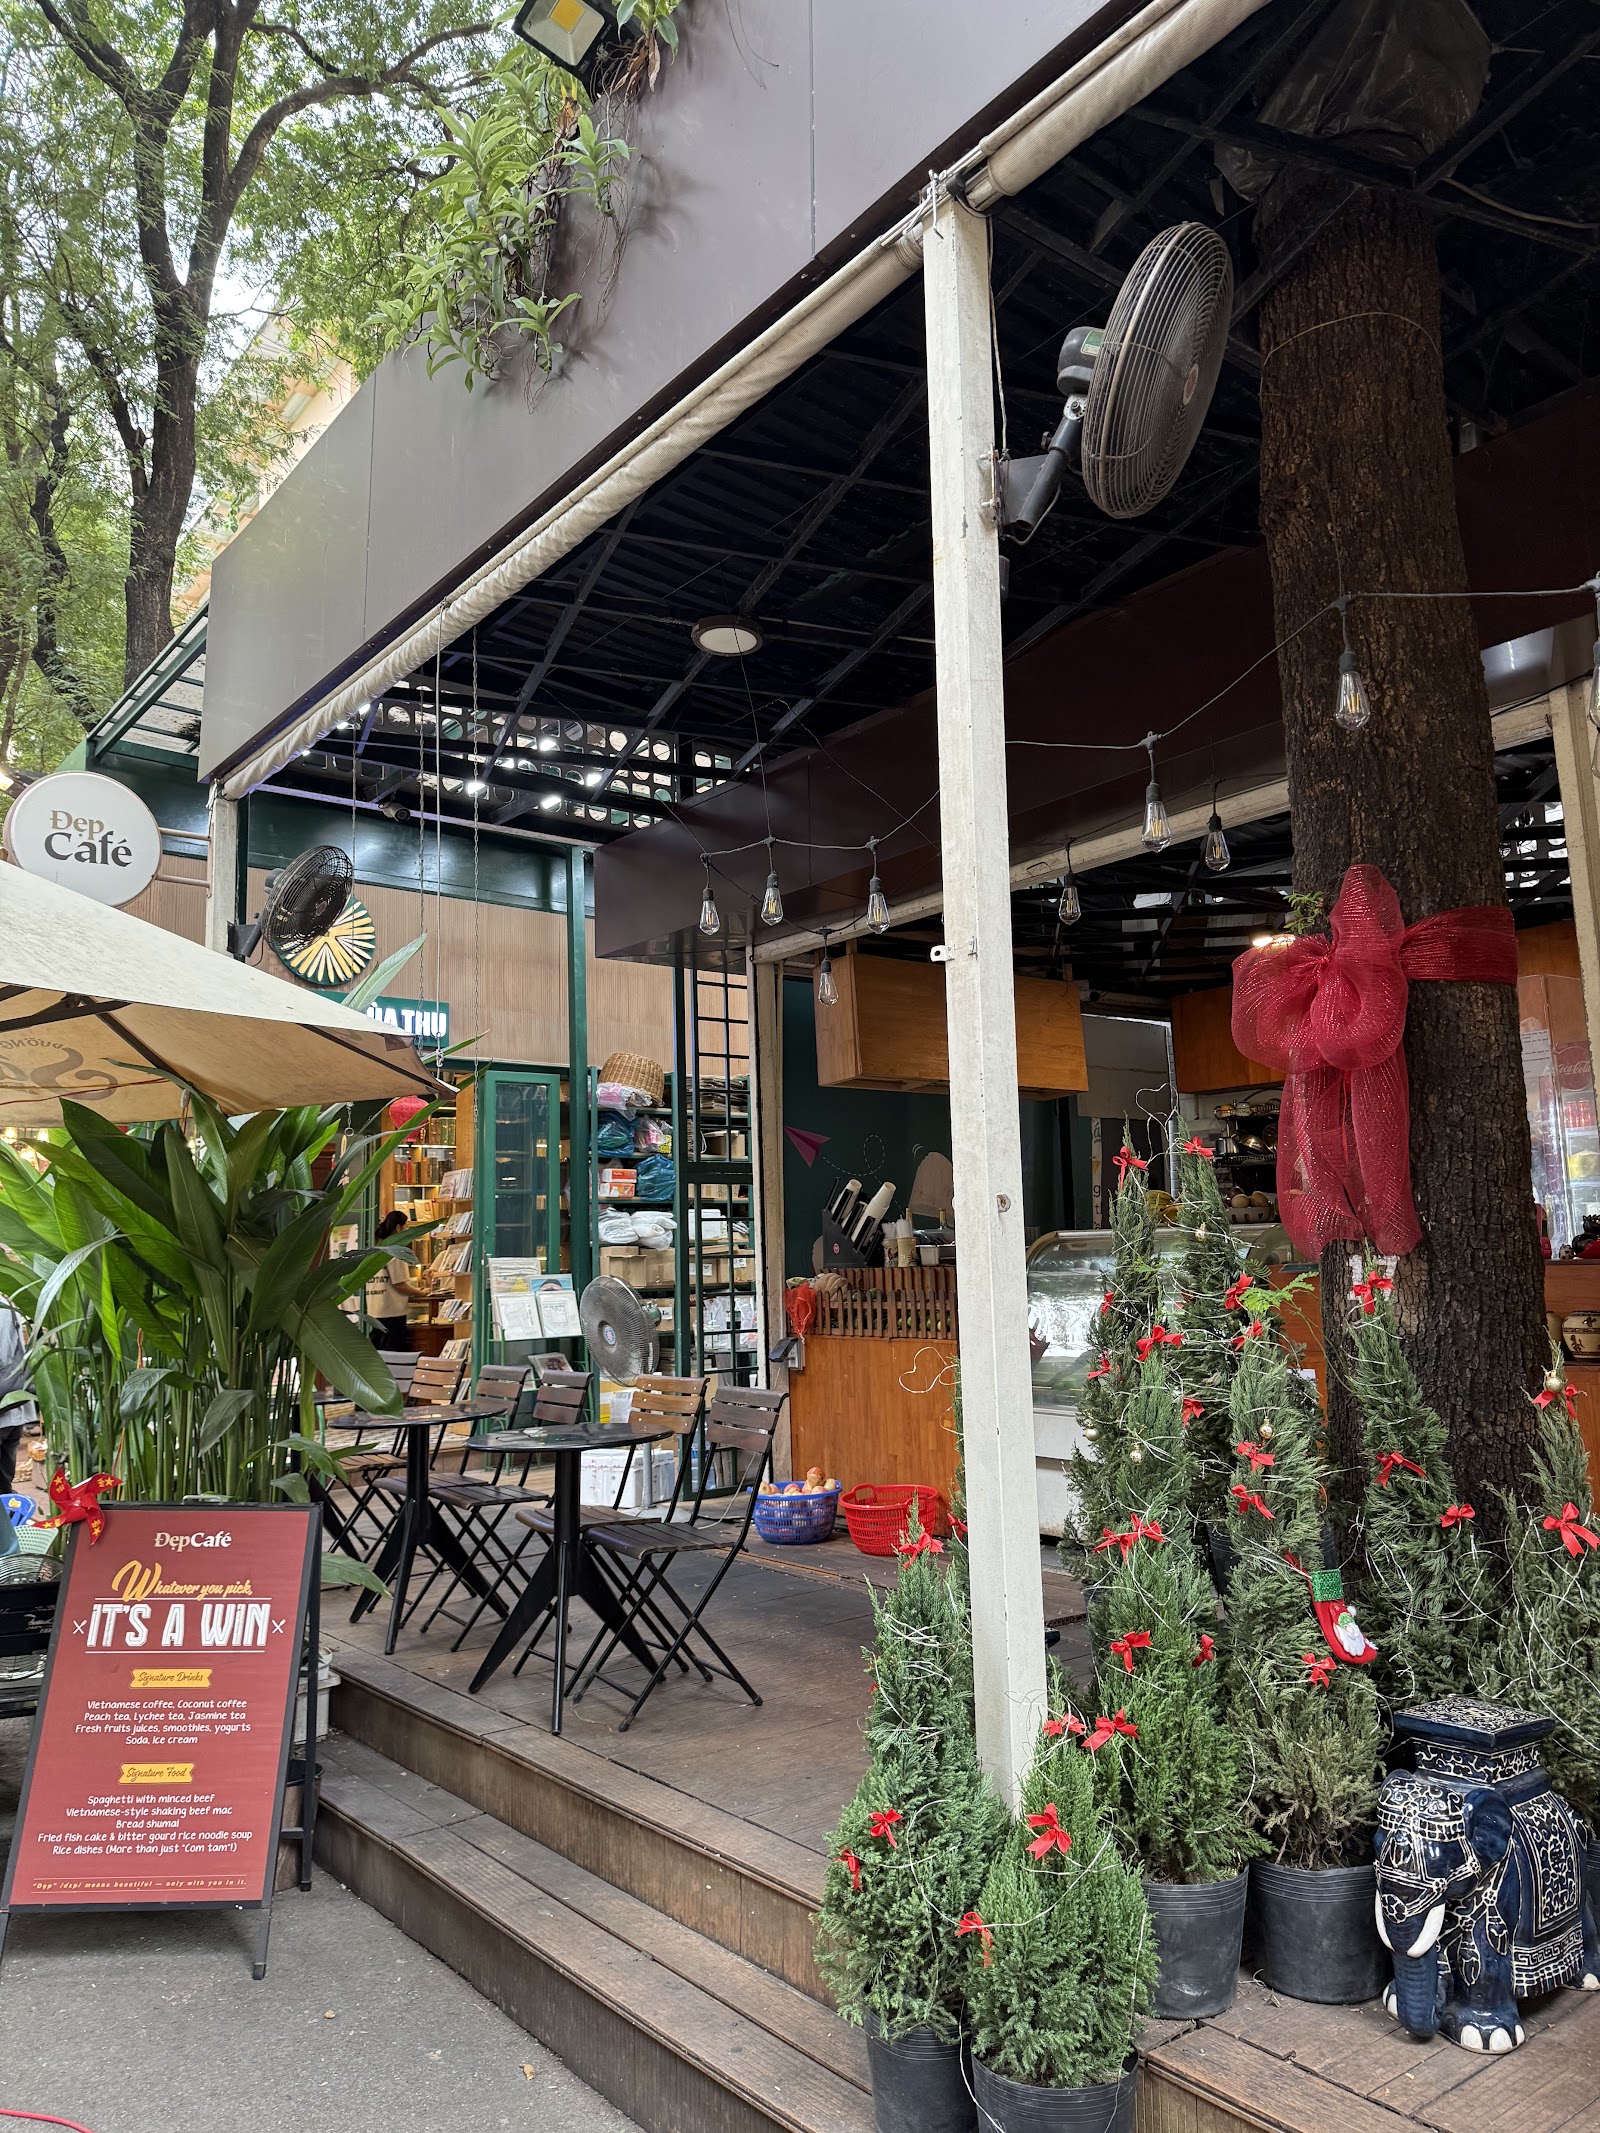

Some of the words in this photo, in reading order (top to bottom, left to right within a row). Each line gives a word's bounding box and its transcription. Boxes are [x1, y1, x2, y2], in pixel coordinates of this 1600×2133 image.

[50, 809, 105, 840] Đẹp
[44, 830, 133, 868] Café
[111, 1560, 200, 1602] Whatever
[196, 1584, 223, 1601] you
[222, 1579, 253, 1598] pick,
[161, 1603, 185, 1647] A
[200, 1603, 271, 1647] WIN
[138, 1671, 175, 1687] Signature
[177, 1671, 204, 1682] Drinks
[87, 1700, 141, 1710] Vietnamese
[177, 1699, 215, 1709] Coconut
[216, 1699, 248, 1709] coffee
[83, 1712, 112, 1721] Peach
[133, 1711, 166, 1724] Lychee
[187, 1711, 228, 1721] Jasmine
[229, 1710, 247, 1720] tea
[74, 1724, 102, 1734] Fresh
[103, 1723, 131, 1734] fruits
[214, 1722, 252, 1735] yogurts
[167, 1736, 199, 1745] cream
[126, 1767, 164, 1782] Signature
[166, 1766, 187, 1778] Food
[87, 1794, 135, 1808] Spaghetti
[135, 1794, 157, 1804] with
[157, 1793, 192, 1804] minced
[193, 1793, 216, 1804] beef
[65, 1806, 150, 1820] Vietnamese-style
[150, 1806, 188, 1819] shaking
[188, 1805, 212, 1816] beef
[211, 1806, 233, 1815] mac
[115, 1817, 145, 1829] Bread
[145, 1818, 180, 1829] shumai
[37, 1832, 63, 1843] Fried
[64, 1832, 83, 1842] fish
[84, 1832, 108, 1842] cake
[117, 1831, 148, 1842] bitter
[148, 1831, 177, 1844] gourd
[177, 1830, 197, 1841] rice
[197, 1830, 230, 1840] noodle
[230, 1831, 253, 1842] soup
[52, 1844, 72, 1855] Rice
[73, 1844, 104, 1855] dishes
[105, 1844, 133, 1855] (More
[134, 1843, 158, 1854] than
[158, 1843, 180, 1857] just
[113, 1880, 153, 1890] beautiful
[165, 1880, 185, 1888] only
